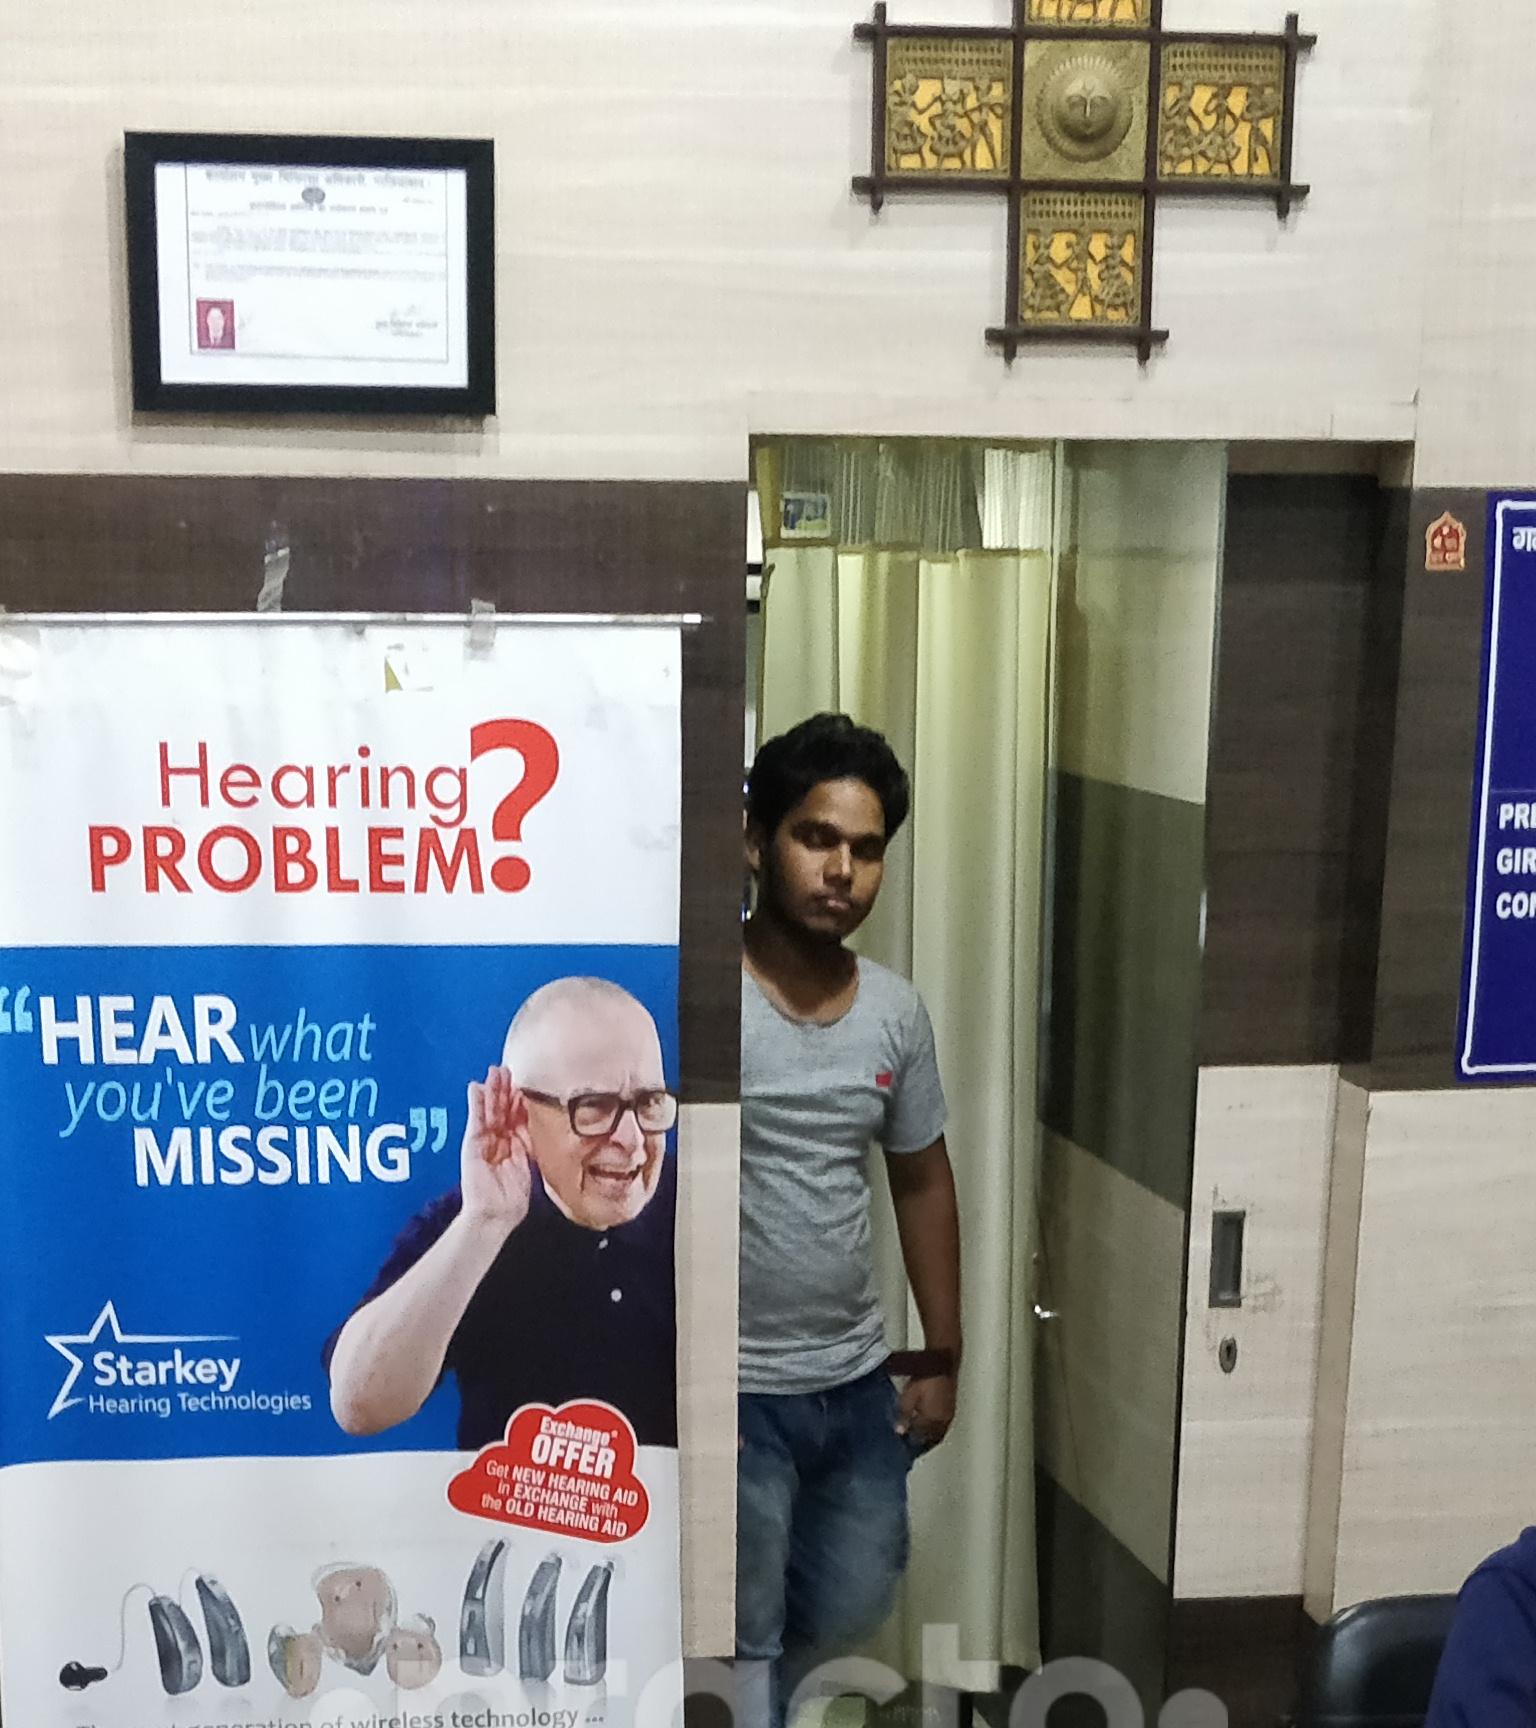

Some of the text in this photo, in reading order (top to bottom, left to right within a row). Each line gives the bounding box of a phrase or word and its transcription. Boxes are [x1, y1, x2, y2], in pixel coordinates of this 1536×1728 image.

[160, 741, 468, 829] Hearing
[250, 1011, 377, 1064] what
[60, 1064, 378, 1137] you've been
[93, 1348, 241, 1392] Starkey
[89, 1390, 312, 1418] Hearing Technologies
[531, 1434, 616, 1479] OFFER
[486, 1459, 639, 1506] Get NEW HEARING AID
[514, 1485, 588, 1512] EXCHANGE
[592, 1502, 618, 1518] with
[481, 1493, 627, 1537] the OLD HEARING AID
